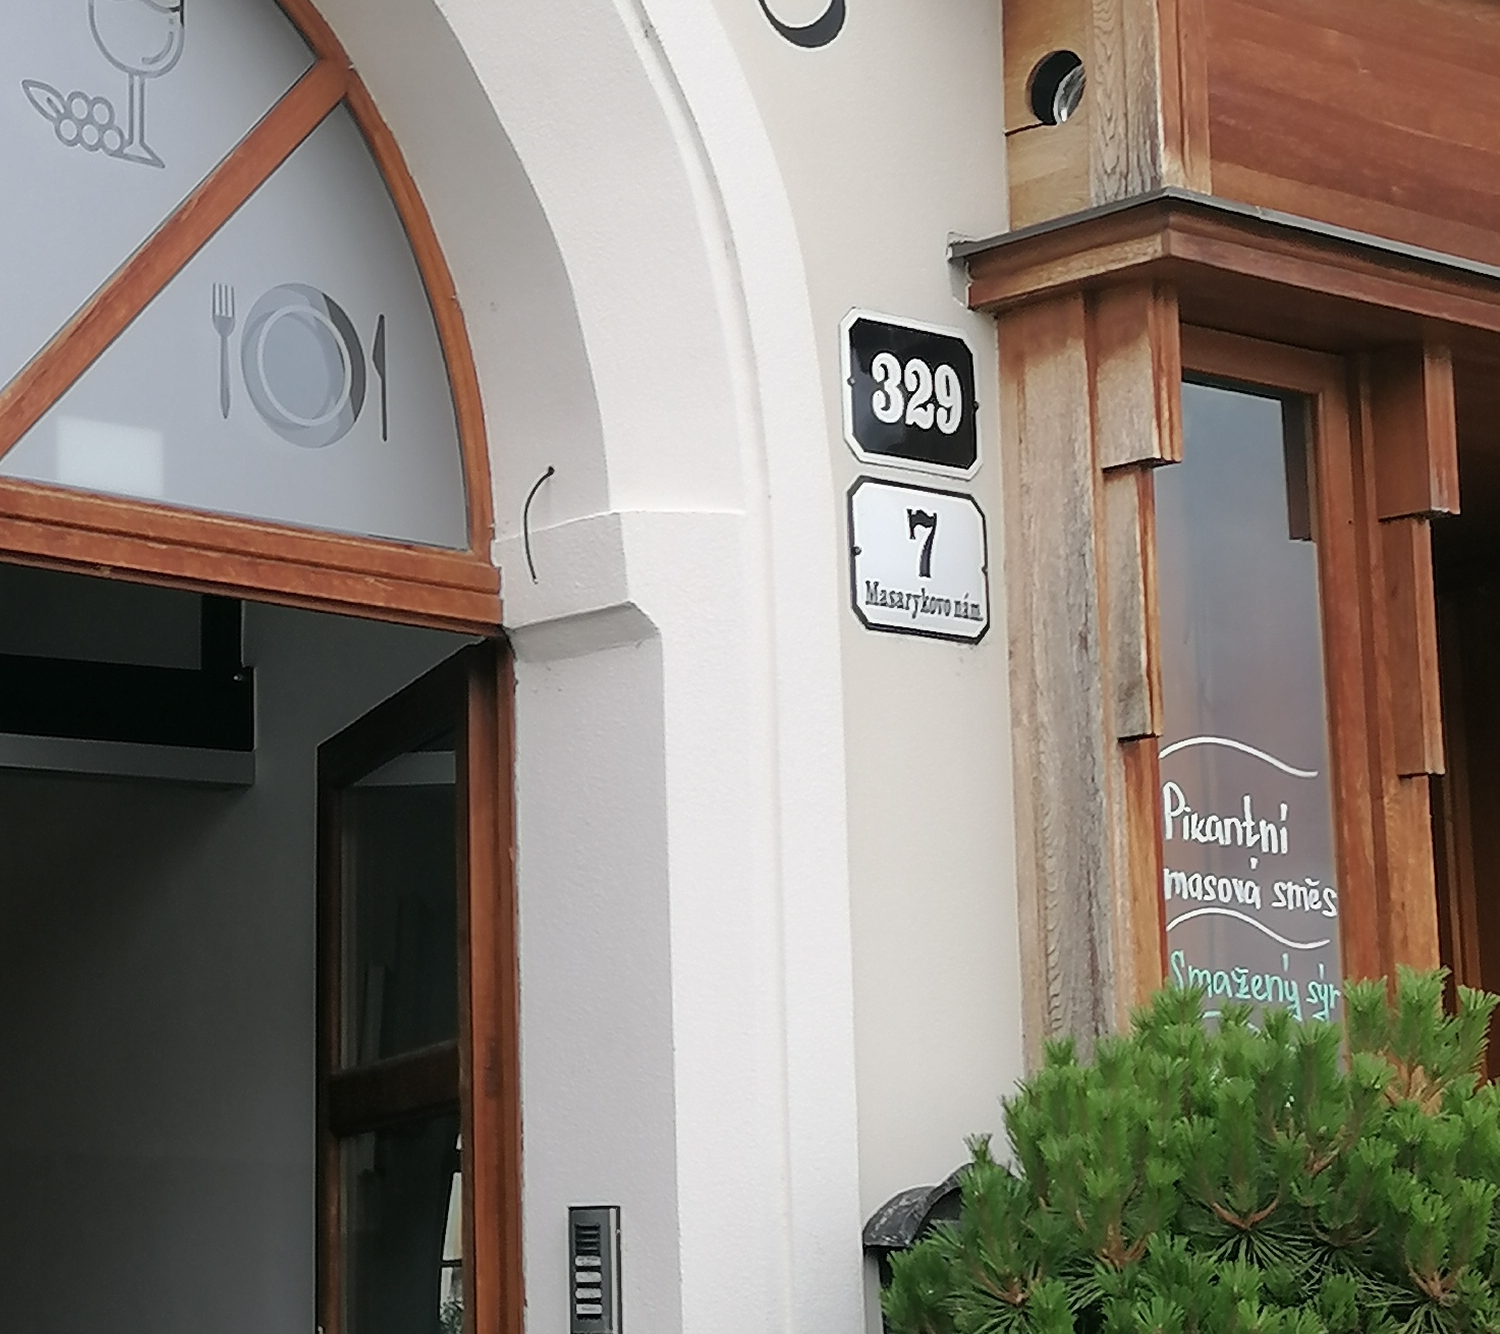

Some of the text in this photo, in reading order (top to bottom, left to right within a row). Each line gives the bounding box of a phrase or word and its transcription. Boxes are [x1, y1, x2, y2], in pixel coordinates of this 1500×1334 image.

[871, 351, 963, 435] 329
[906, 508, 938, 578] 7
[865, 580, 951, 619] Masarykovo
[1272, 877, 1339, 917] směs
